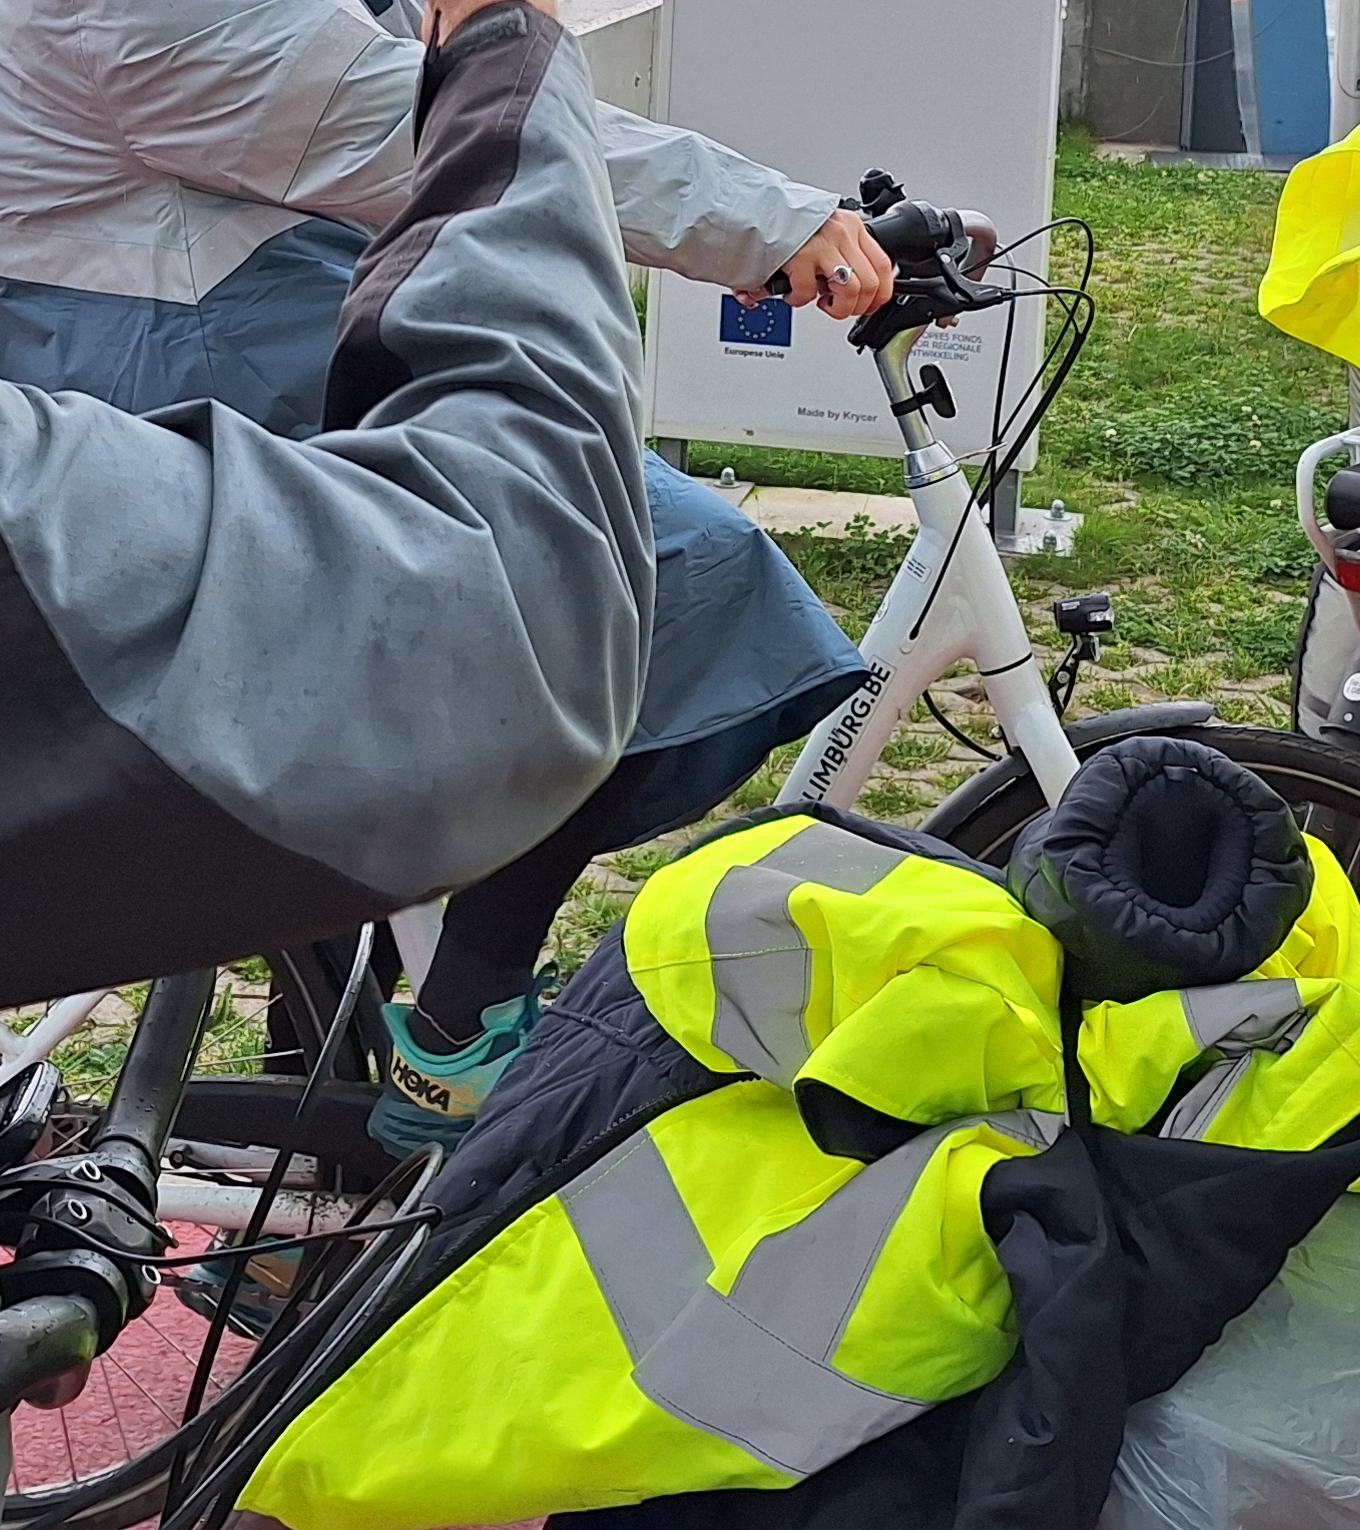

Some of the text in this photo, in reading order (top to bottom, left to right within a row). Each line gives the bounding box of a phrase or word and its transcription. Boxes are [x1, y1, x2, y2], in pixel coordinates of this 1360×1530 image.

[952, 333, 982, 344] FONDS
[724, 346, 785, 359] Europese Unie
[932, 341, 982, 353] REGIONALE
[797, 406, 825, 418] Made
[827, 409, 840, 420] by
[392, 1056, 451, 1112] HOKA
